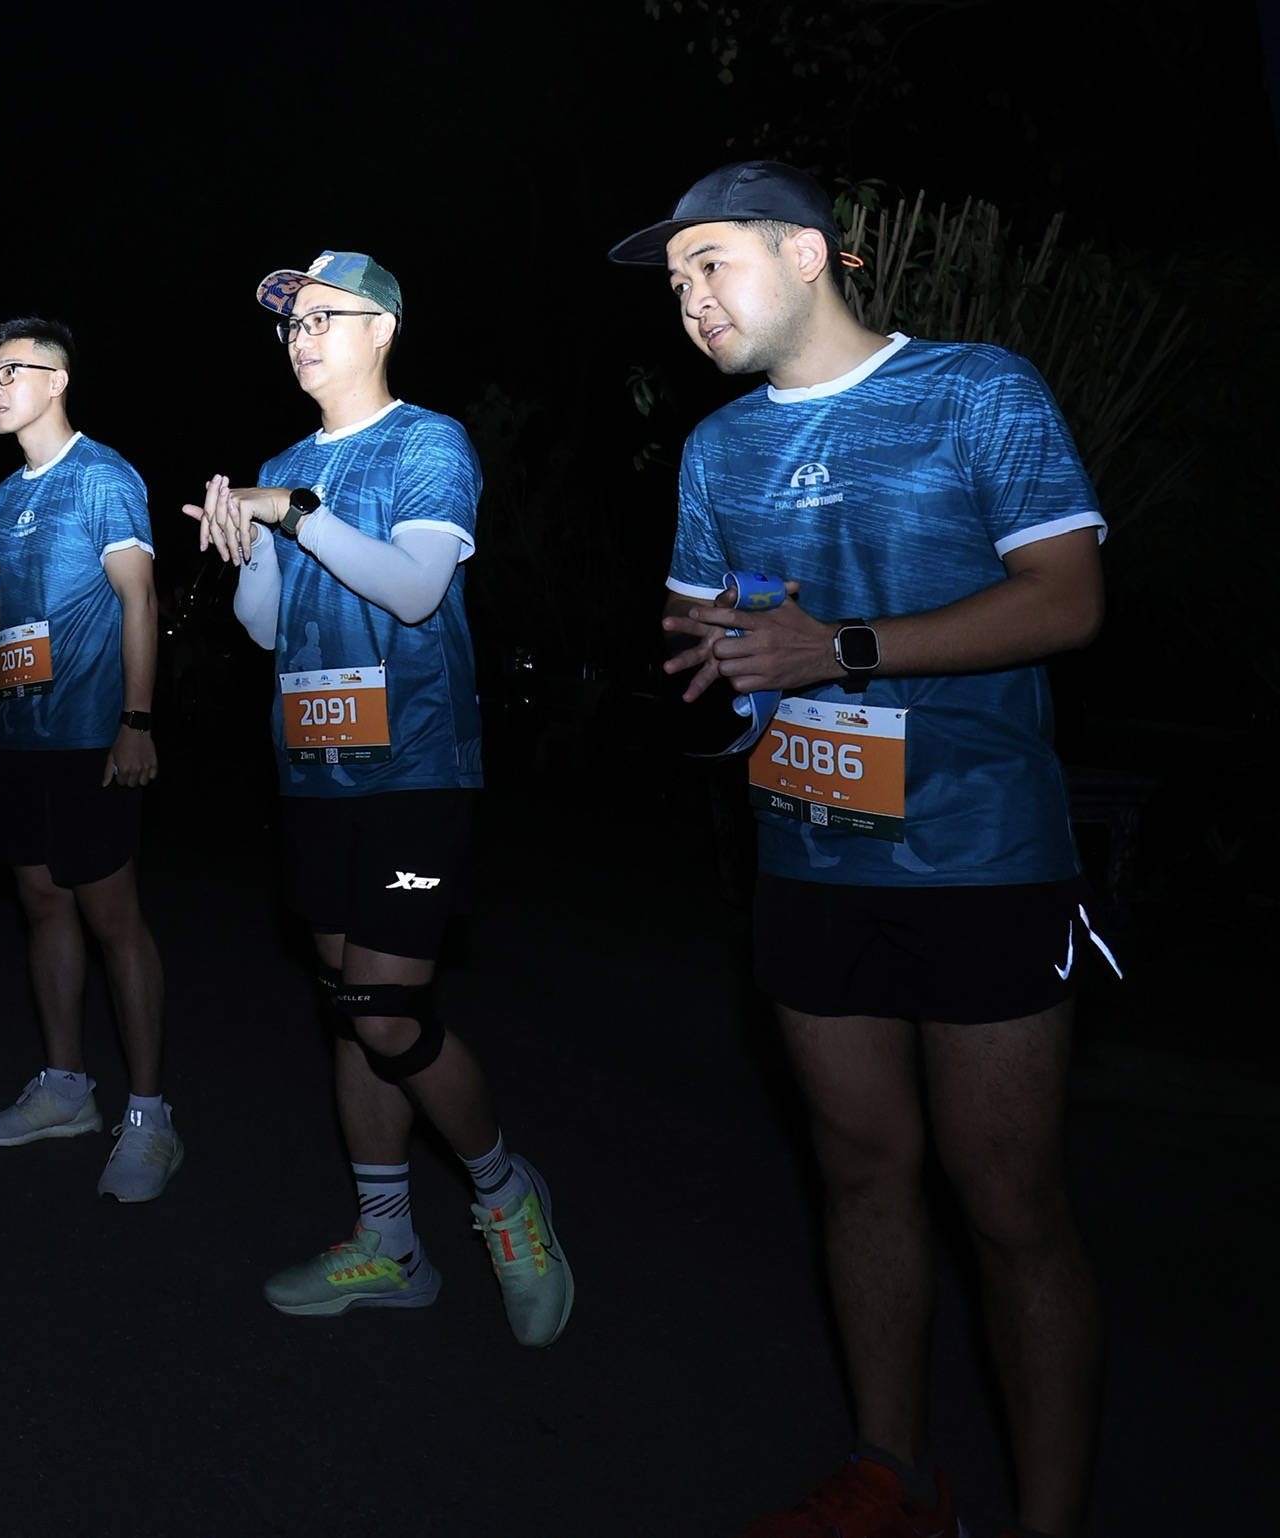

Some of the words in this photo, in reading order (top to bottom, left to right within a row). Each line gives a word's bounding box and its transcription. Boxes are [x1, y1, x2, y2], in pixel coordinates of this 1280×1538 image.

[1, 646, 35, 672] 2075
[299, 696, 357, 726] 2091
[770, 729, 864, 780] 2086
[770, 795, 794, 812] 21km
